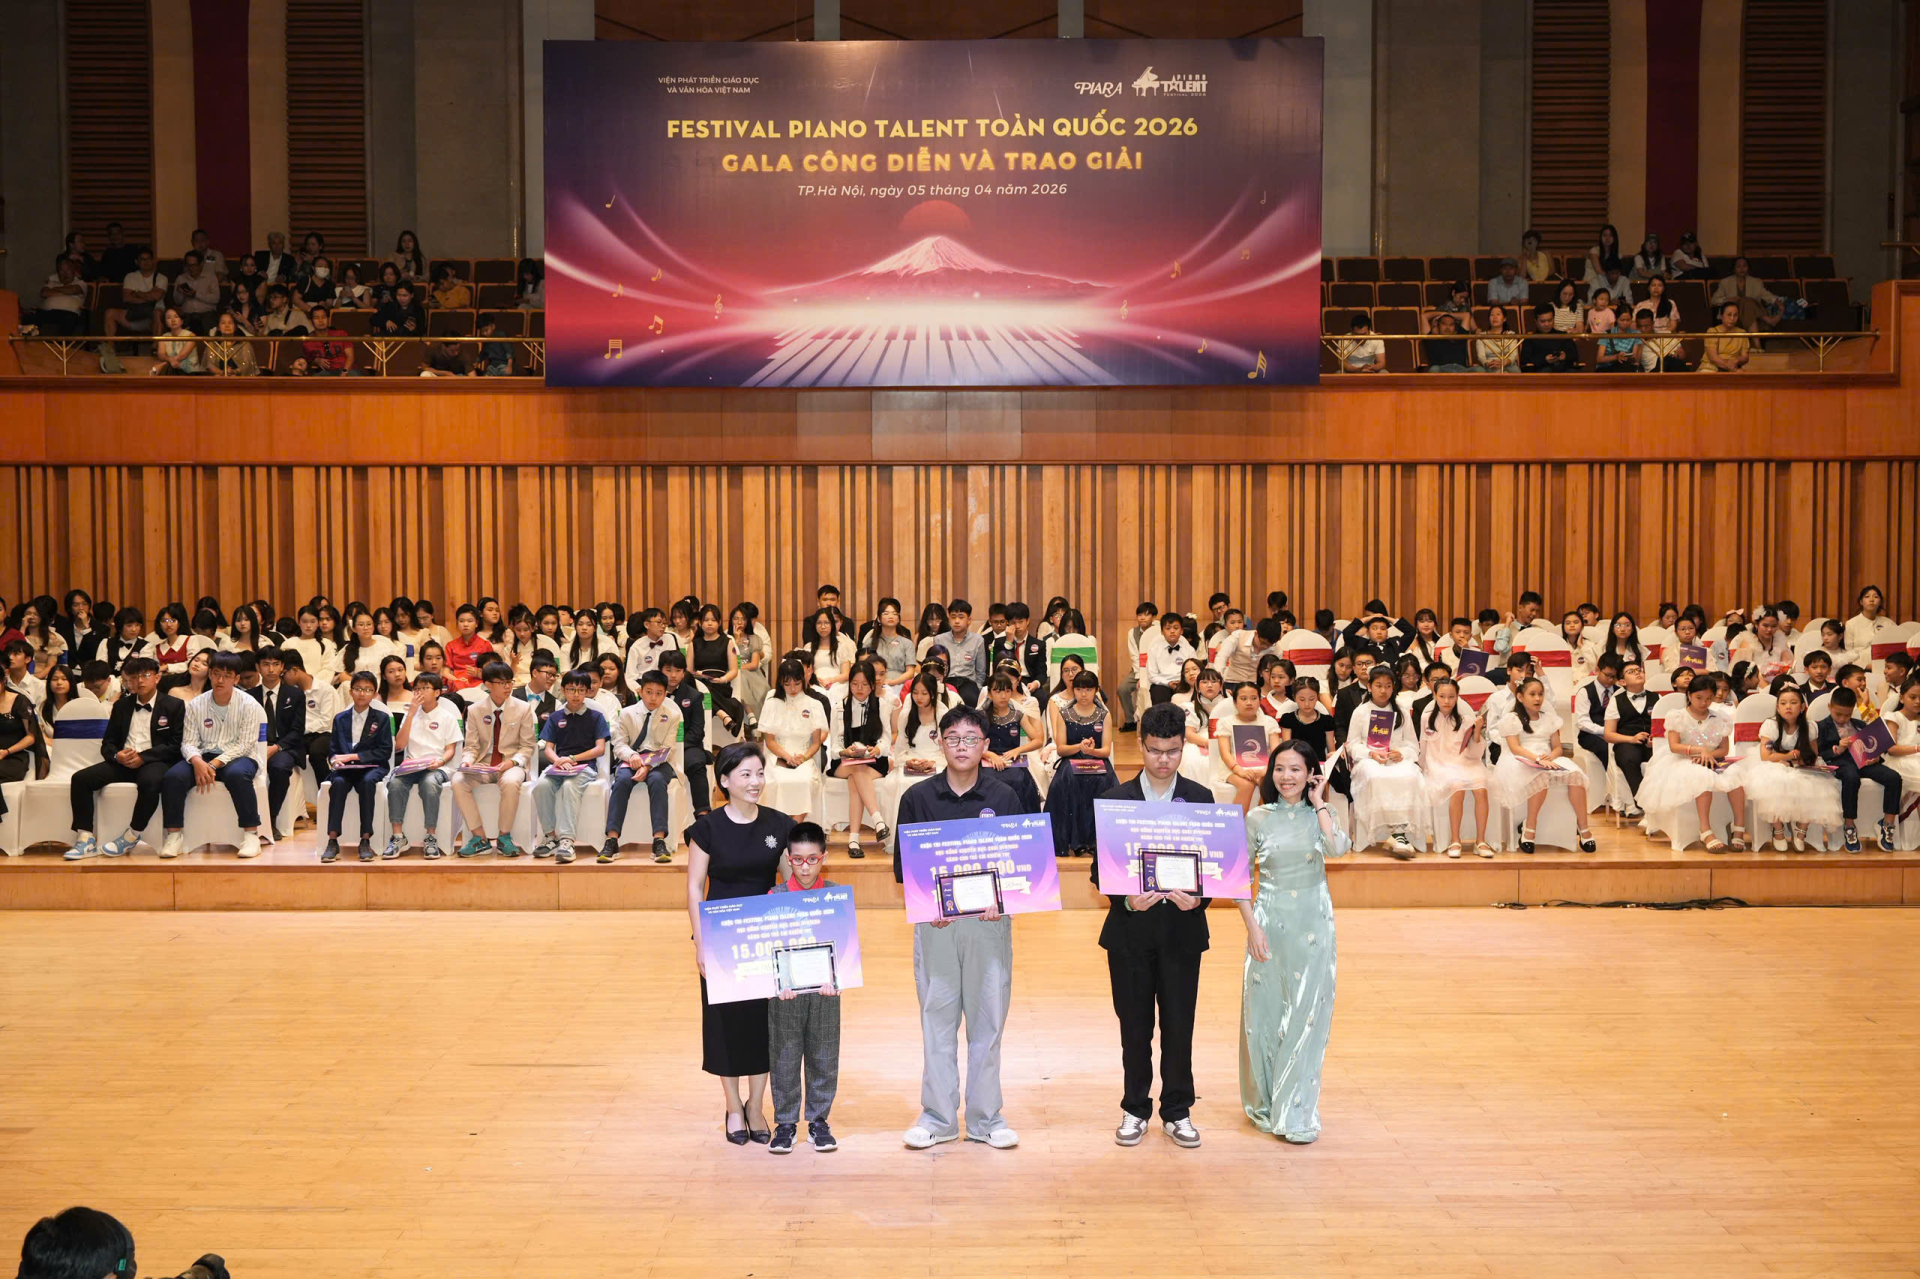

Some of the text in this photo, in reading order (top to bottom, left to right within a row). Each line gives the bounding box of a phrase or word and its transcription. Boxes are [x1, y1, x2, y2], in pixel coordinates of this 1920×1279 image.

[658, 75, 759, 85] VIỆN PHÁT TRIỂN GIÁO DỤC
[1160, 79, 1208, 92] TALENT
[715, 86, 731, 94] VIỆT
[1074, 82, 1123, 98] PIARA
[667, 109, 1198, 138] FESTIVAL PIANO TALENT TOÀN QUỐC 2026
[721, 146, 1142, 172] GALA CÔNG DIỄN VÀ TRAO GIẢI
[797, 183, 1068, 198] TP.Hà Nội, ngày 05 tháng 04 năm 2026
